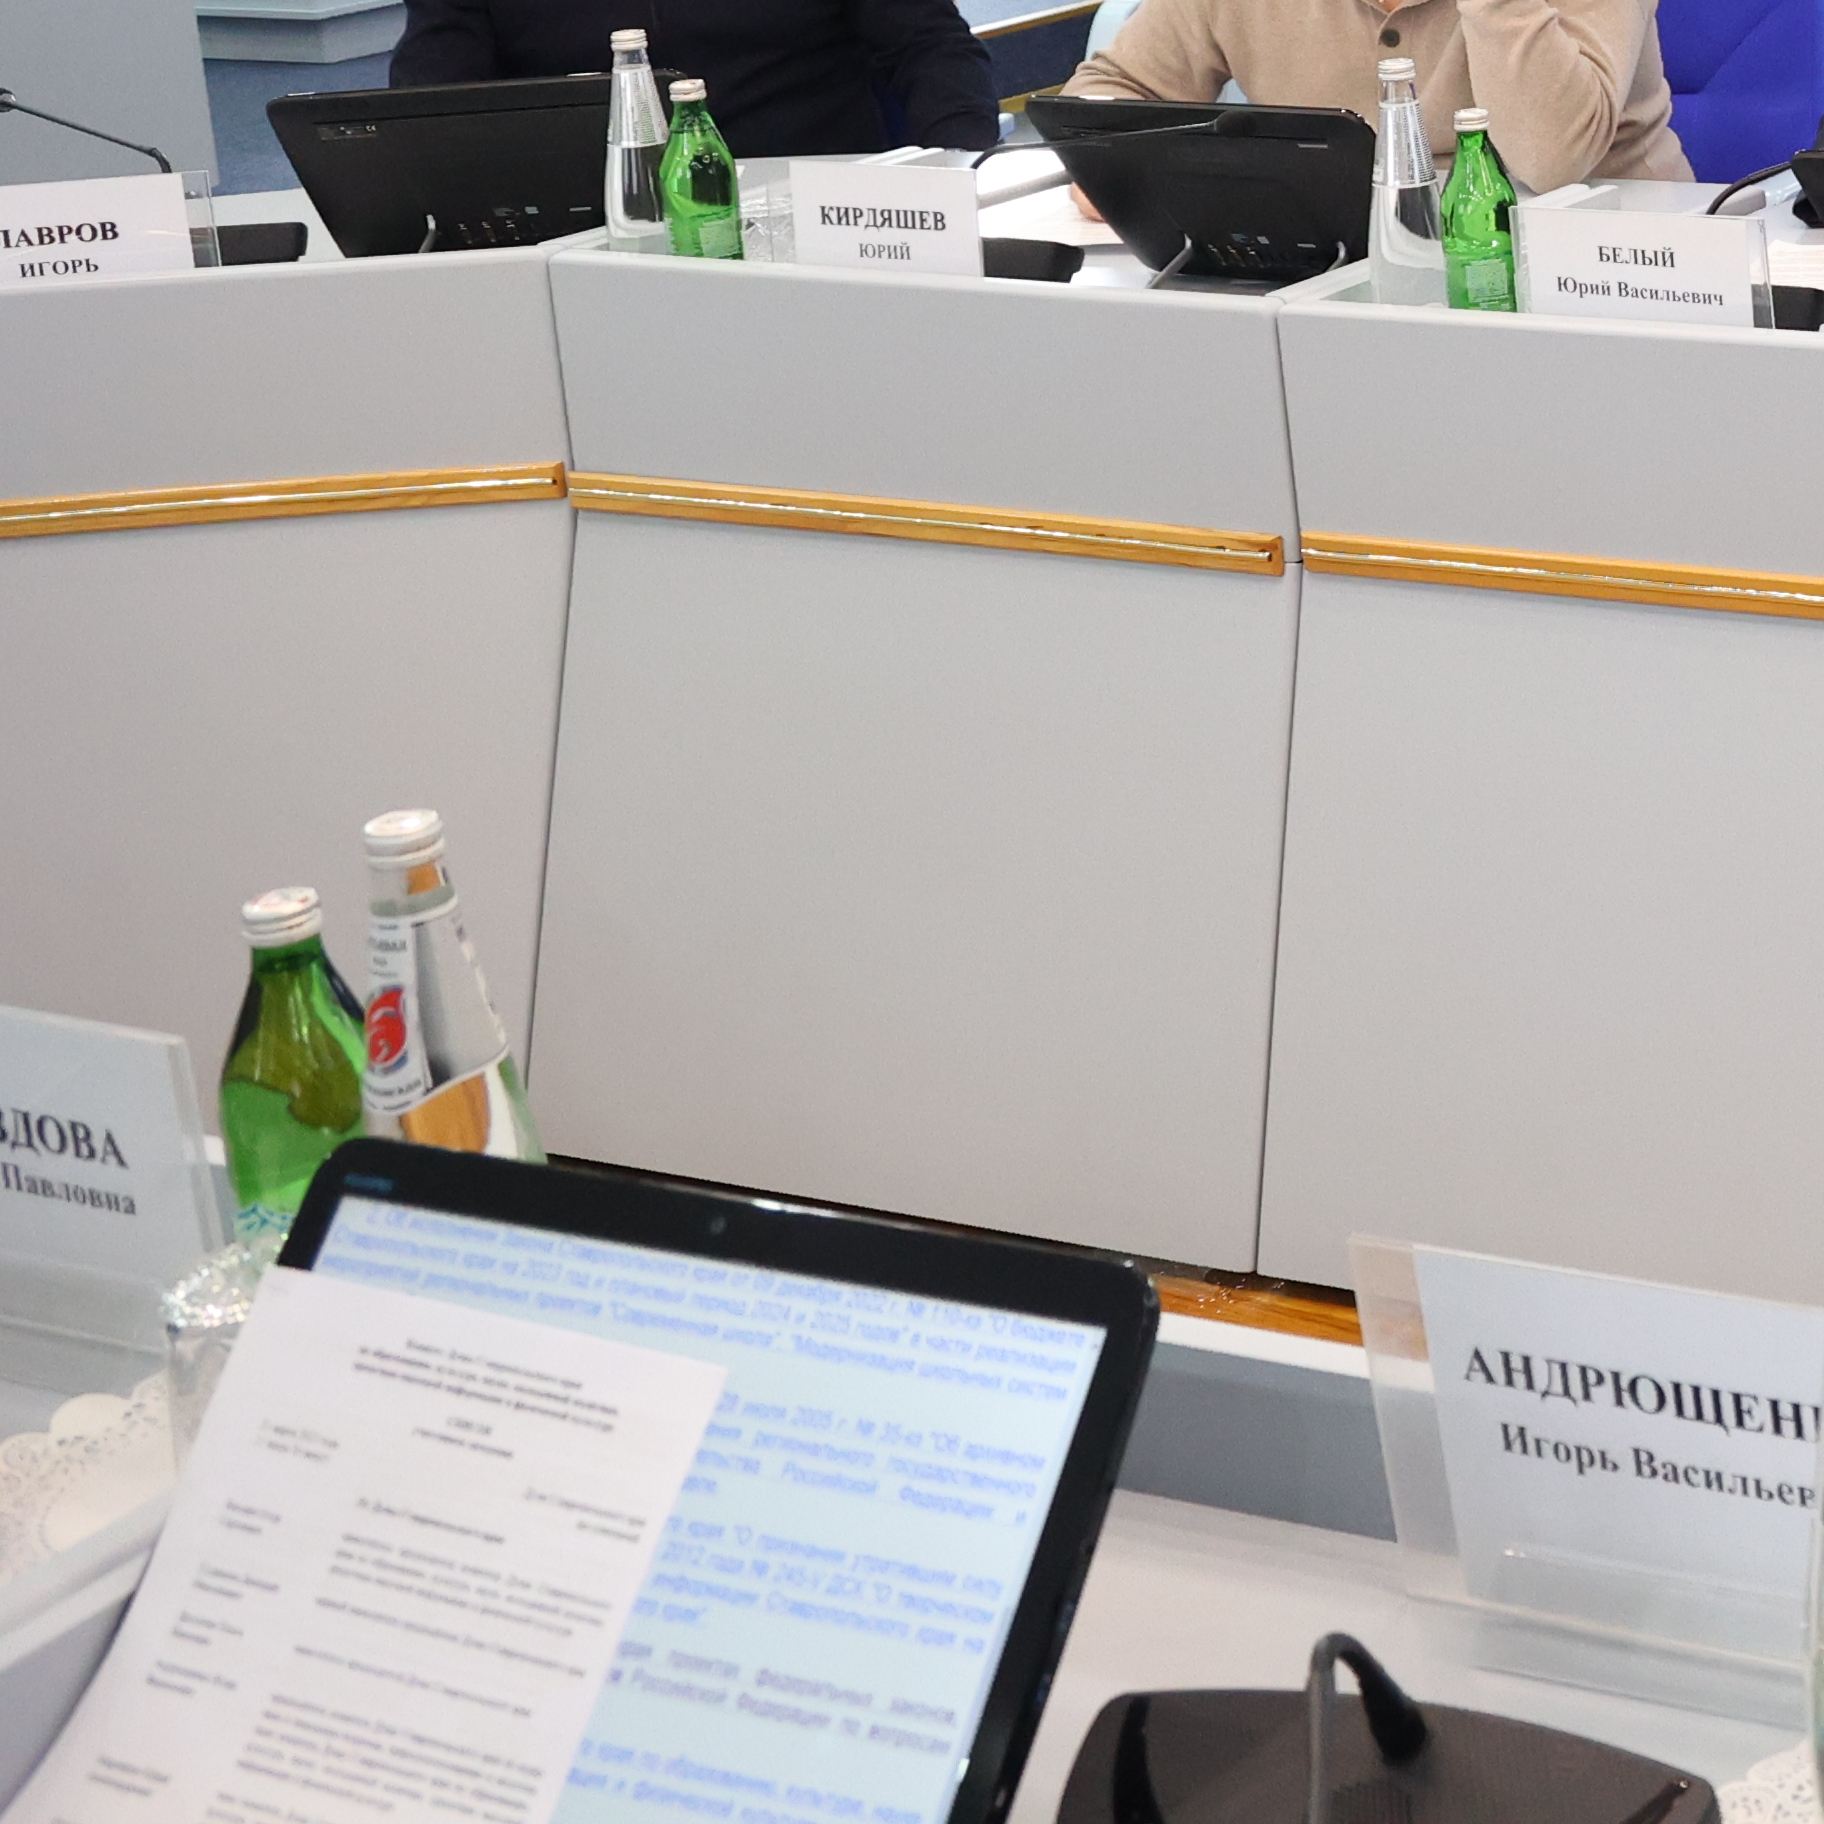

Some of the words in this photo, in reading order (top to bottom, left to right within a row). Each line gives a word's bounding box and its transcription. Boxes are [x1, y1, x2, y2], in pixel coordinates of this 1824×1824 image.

[819, 205, 946, 231] КИРДЯШЕВ
[859, 242, 911, 260] ЮРИЙ
[1597, 245, 1675, 268] БЕЛЫЙ
[19, 258, 99, 278] ИГОРЬ
[1557, 276, 1611, 298] Юрий
[1617, 281, 1723, 306] Васильевич
[1, 1162, 136, 1215] Павловна
[1464, 1346, 1822, 1443] АНДРЮЩЕН
[1499, 1422, 1620, 1475] Игорь
[1632, 1446, 1817, 1509] Васильев
